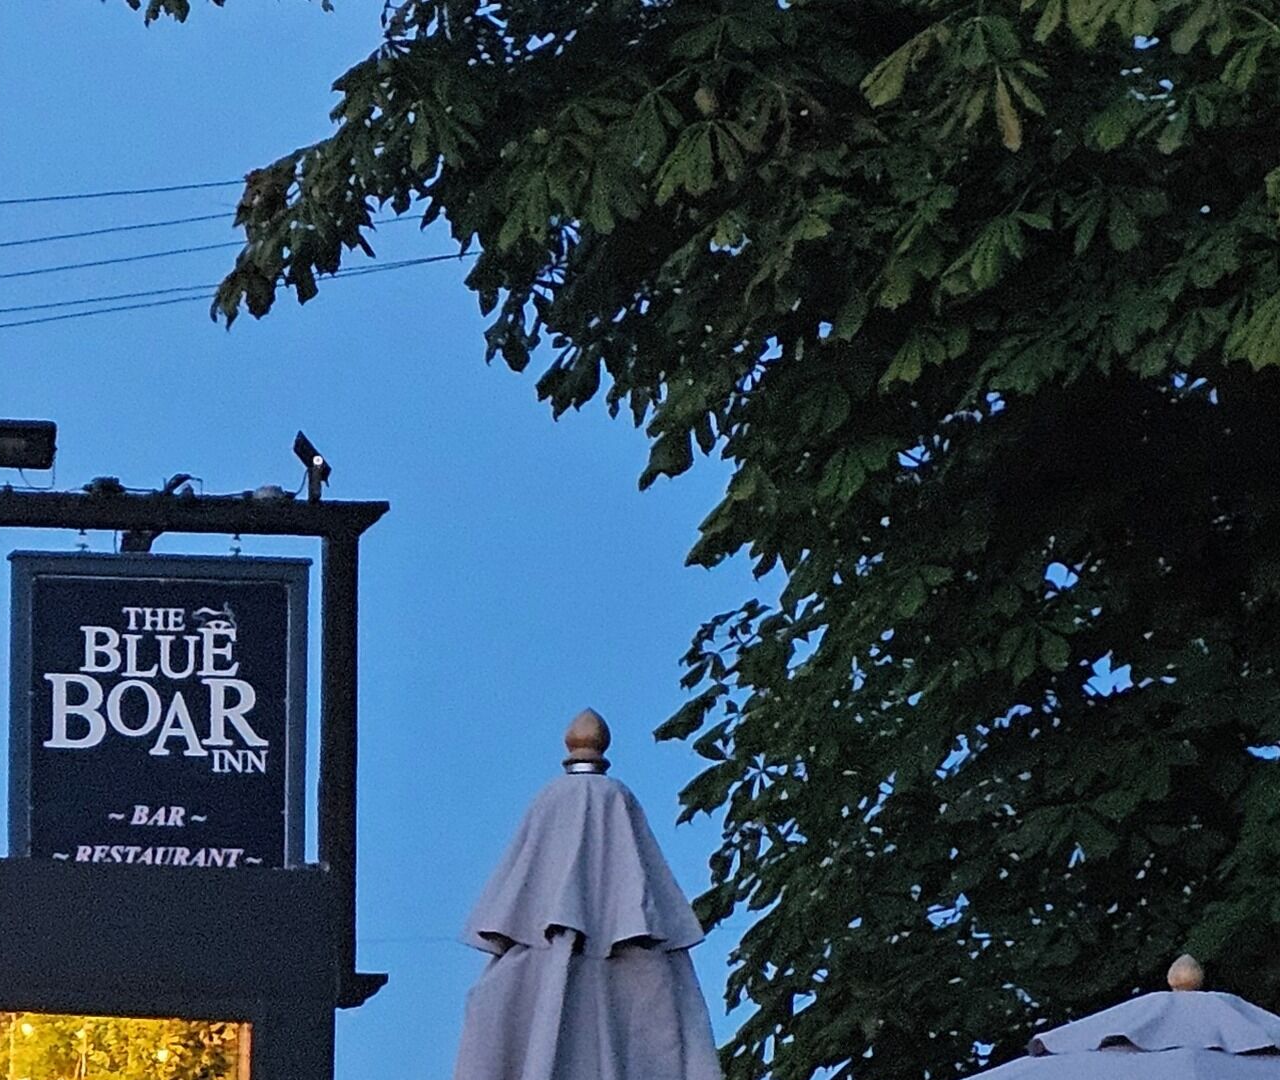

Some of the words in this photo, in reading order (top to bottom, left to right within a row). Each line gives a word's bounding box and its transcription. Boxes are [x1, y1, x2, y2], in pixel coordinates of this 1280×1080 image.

[122, 607, 185, 632] THE
[79, 625, 239, 680] BLUE
[43, 672, 269, 757] BOAR
[212, 750, 268, 774] INN
